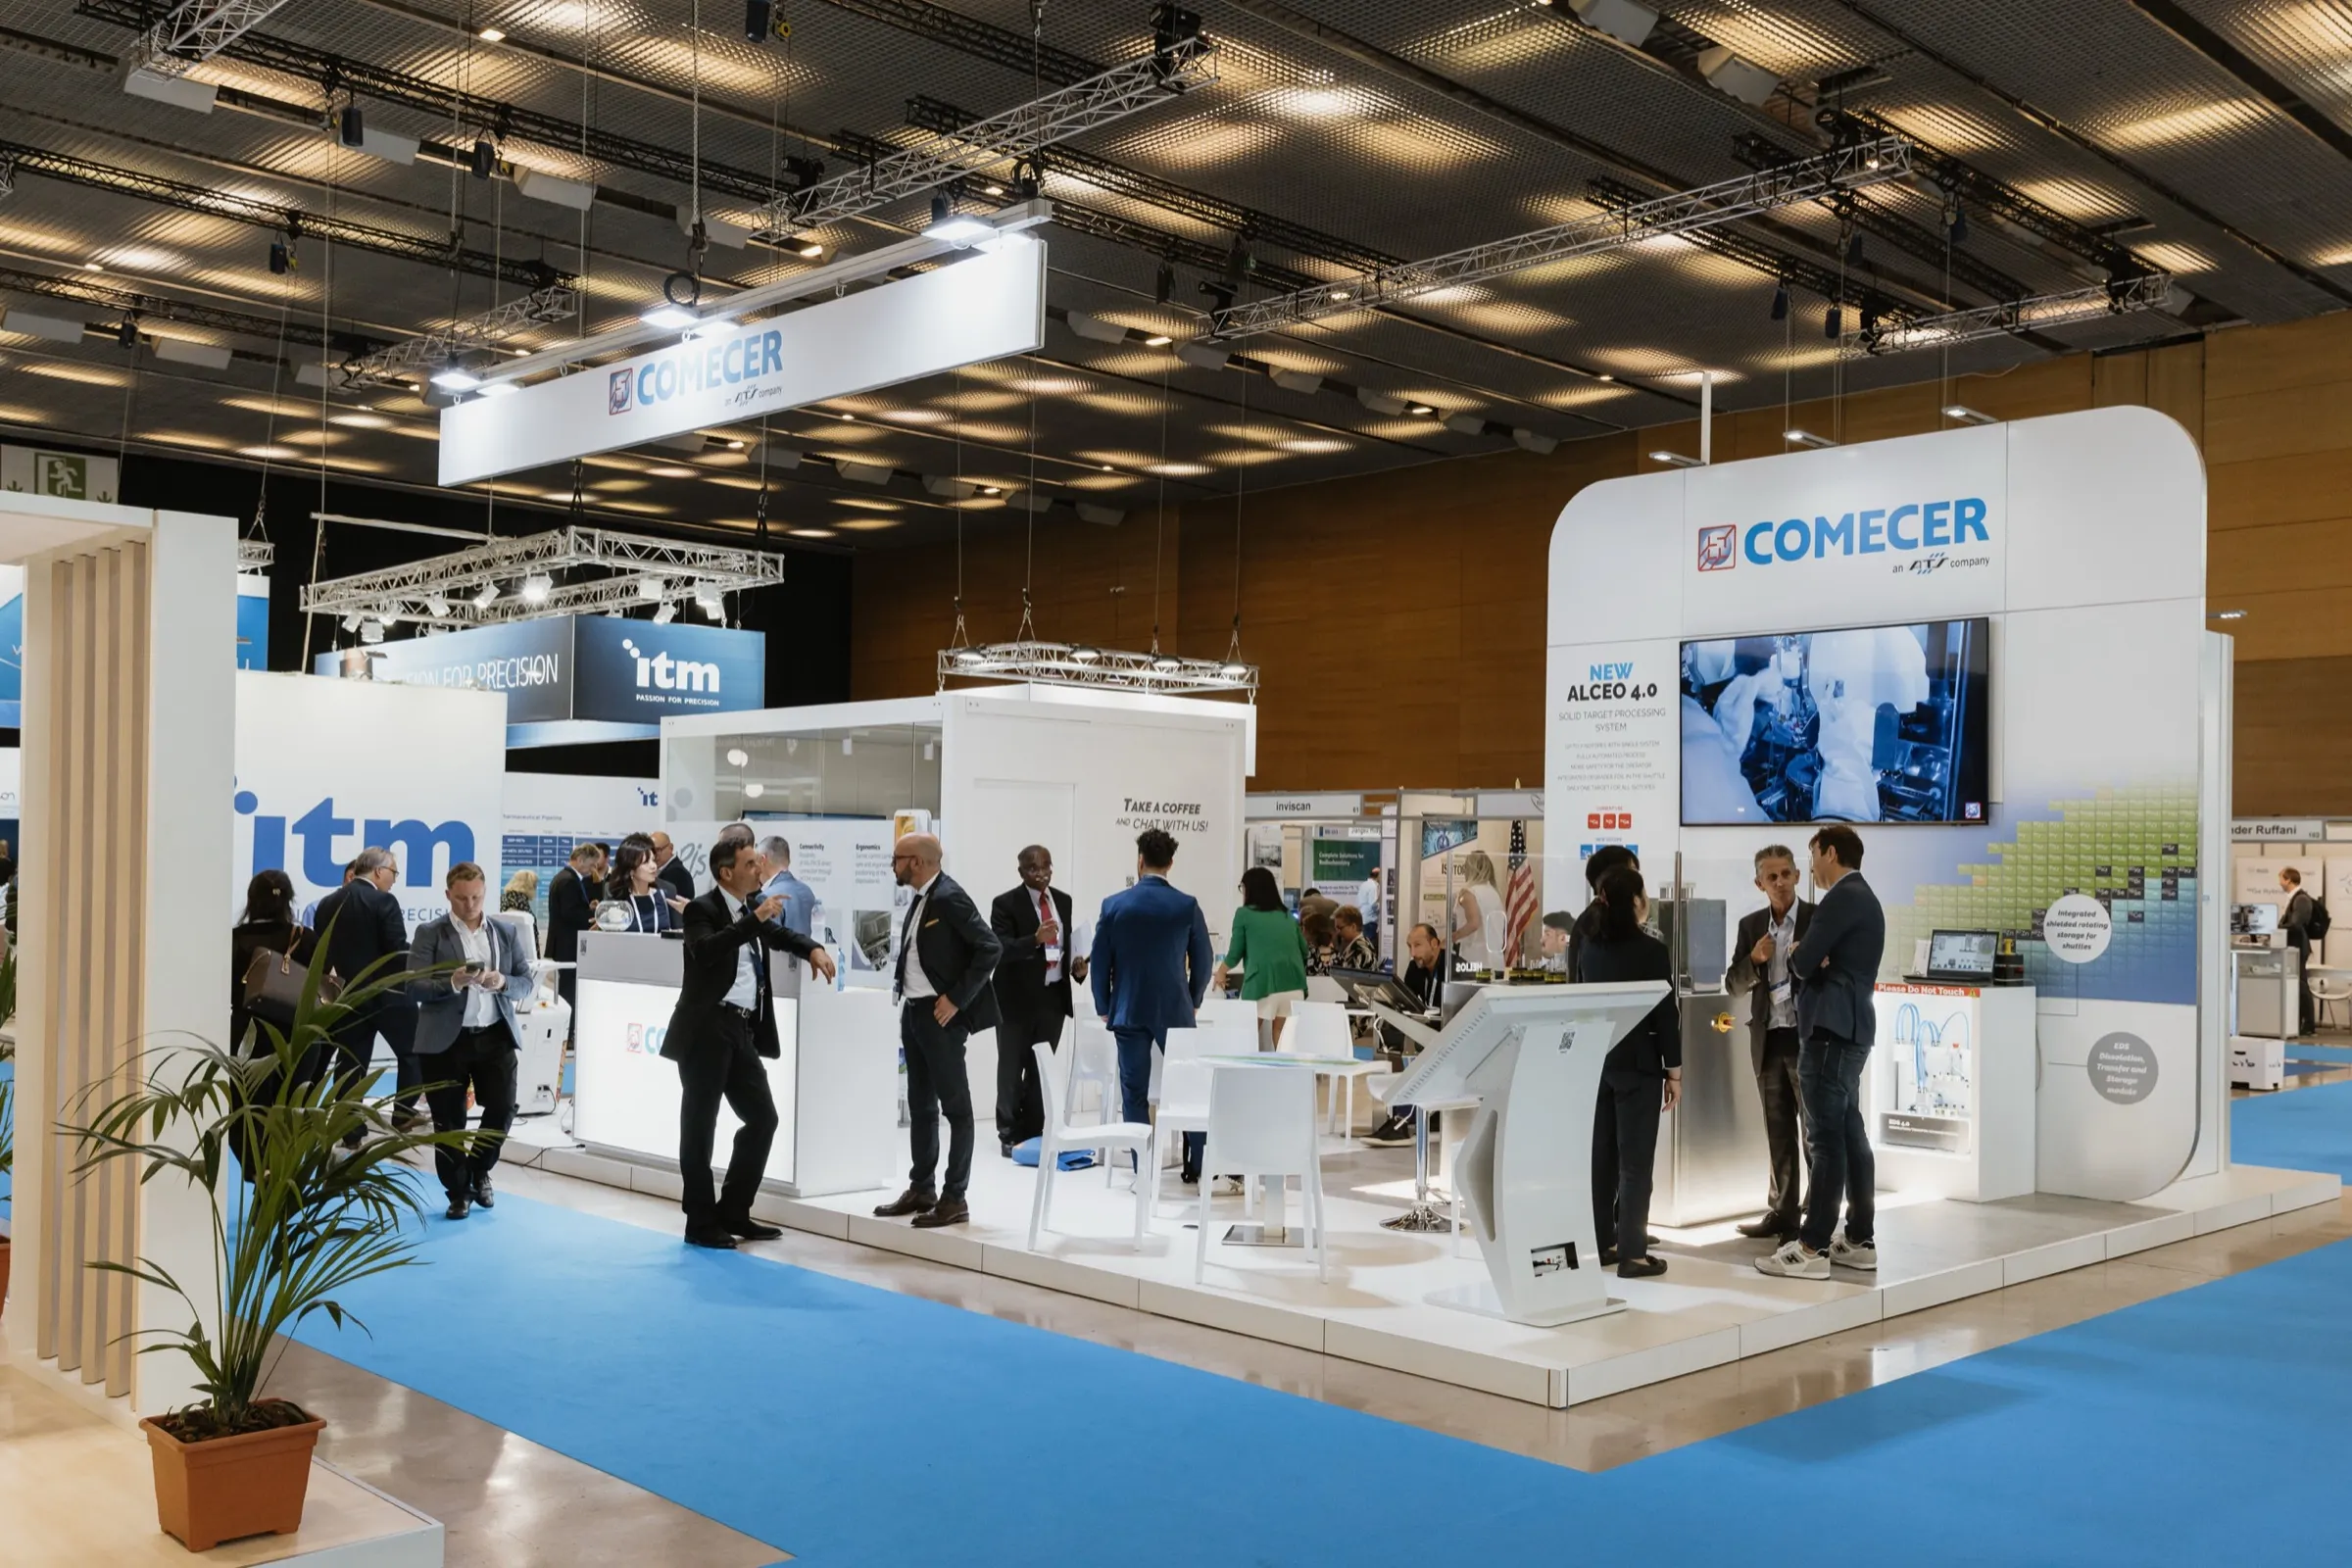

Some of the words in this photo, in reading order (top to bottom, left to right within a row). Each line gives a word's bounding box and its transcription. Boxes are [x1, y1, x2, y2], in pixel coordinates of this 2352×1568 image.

[637, 329, 783, 406] COMECER
[1744, 497, 1989, 565] COMECER
[1892, 564, 1904, 574] an
[1950, 556, 1990, 569] company
[477, 654, 559, 690] PRECISION
[622, 638, 720, 693] itm
[1590, 662, 1634, 681] NEW
[1567, 682, 1627, 702] ALCEO
[1630, 682, 1658, 701] 4.0
[636, 694, 665, 704] PASSION
[668, 696, 682, 705] FOR
[684, 697, 719, 707] PRECISION
[1558, 711, 1582, 721] SOLID
[1584, 710, 1613, 720] TARGET
[1614, 708, 1666, 718] PROCESSING
[1594, 722, 1627, 732] SYSTEM
[637, 787, 658, 806] it
[1152, 802, 1160, 813] A
[1162, 803, 1201, 814] COFFEE
[1276, 801, 1311, 811] inviscan
[232, 774, 475, 887] itm
[1116, 817, 1131, 826] AND
[1133, 818, 1161, 831] CHAT
[1162, 819, 1190, 831] WITH
[1192, 820, 1209, 833] US!
[2256, 825, 2297, 835] Ruffani
[799, 843, 824, 852] Connectivity
[856, 843, 881, 852] Ergonomics
[2058, 909, 2096, 918] Integrated
[2057, 931, 2084, 941] storage
[2086, 931, 2097, 941] for
[2062, 941, 2092, 951] shuttles
[1878, 983, 1906, 994] Please
[1907, 985, 1920, 994] Do
[1921, 986, 1936, 995] Not
[1938, 987, 1965, 997] Touch
[2114, 1042, 2130, 1051] EDS
[2096, 1063, 2130, 1074] Transfer
[2131, 1065, 2147, 1074] and
[2106, 1074, 2138, 1086] Storage
